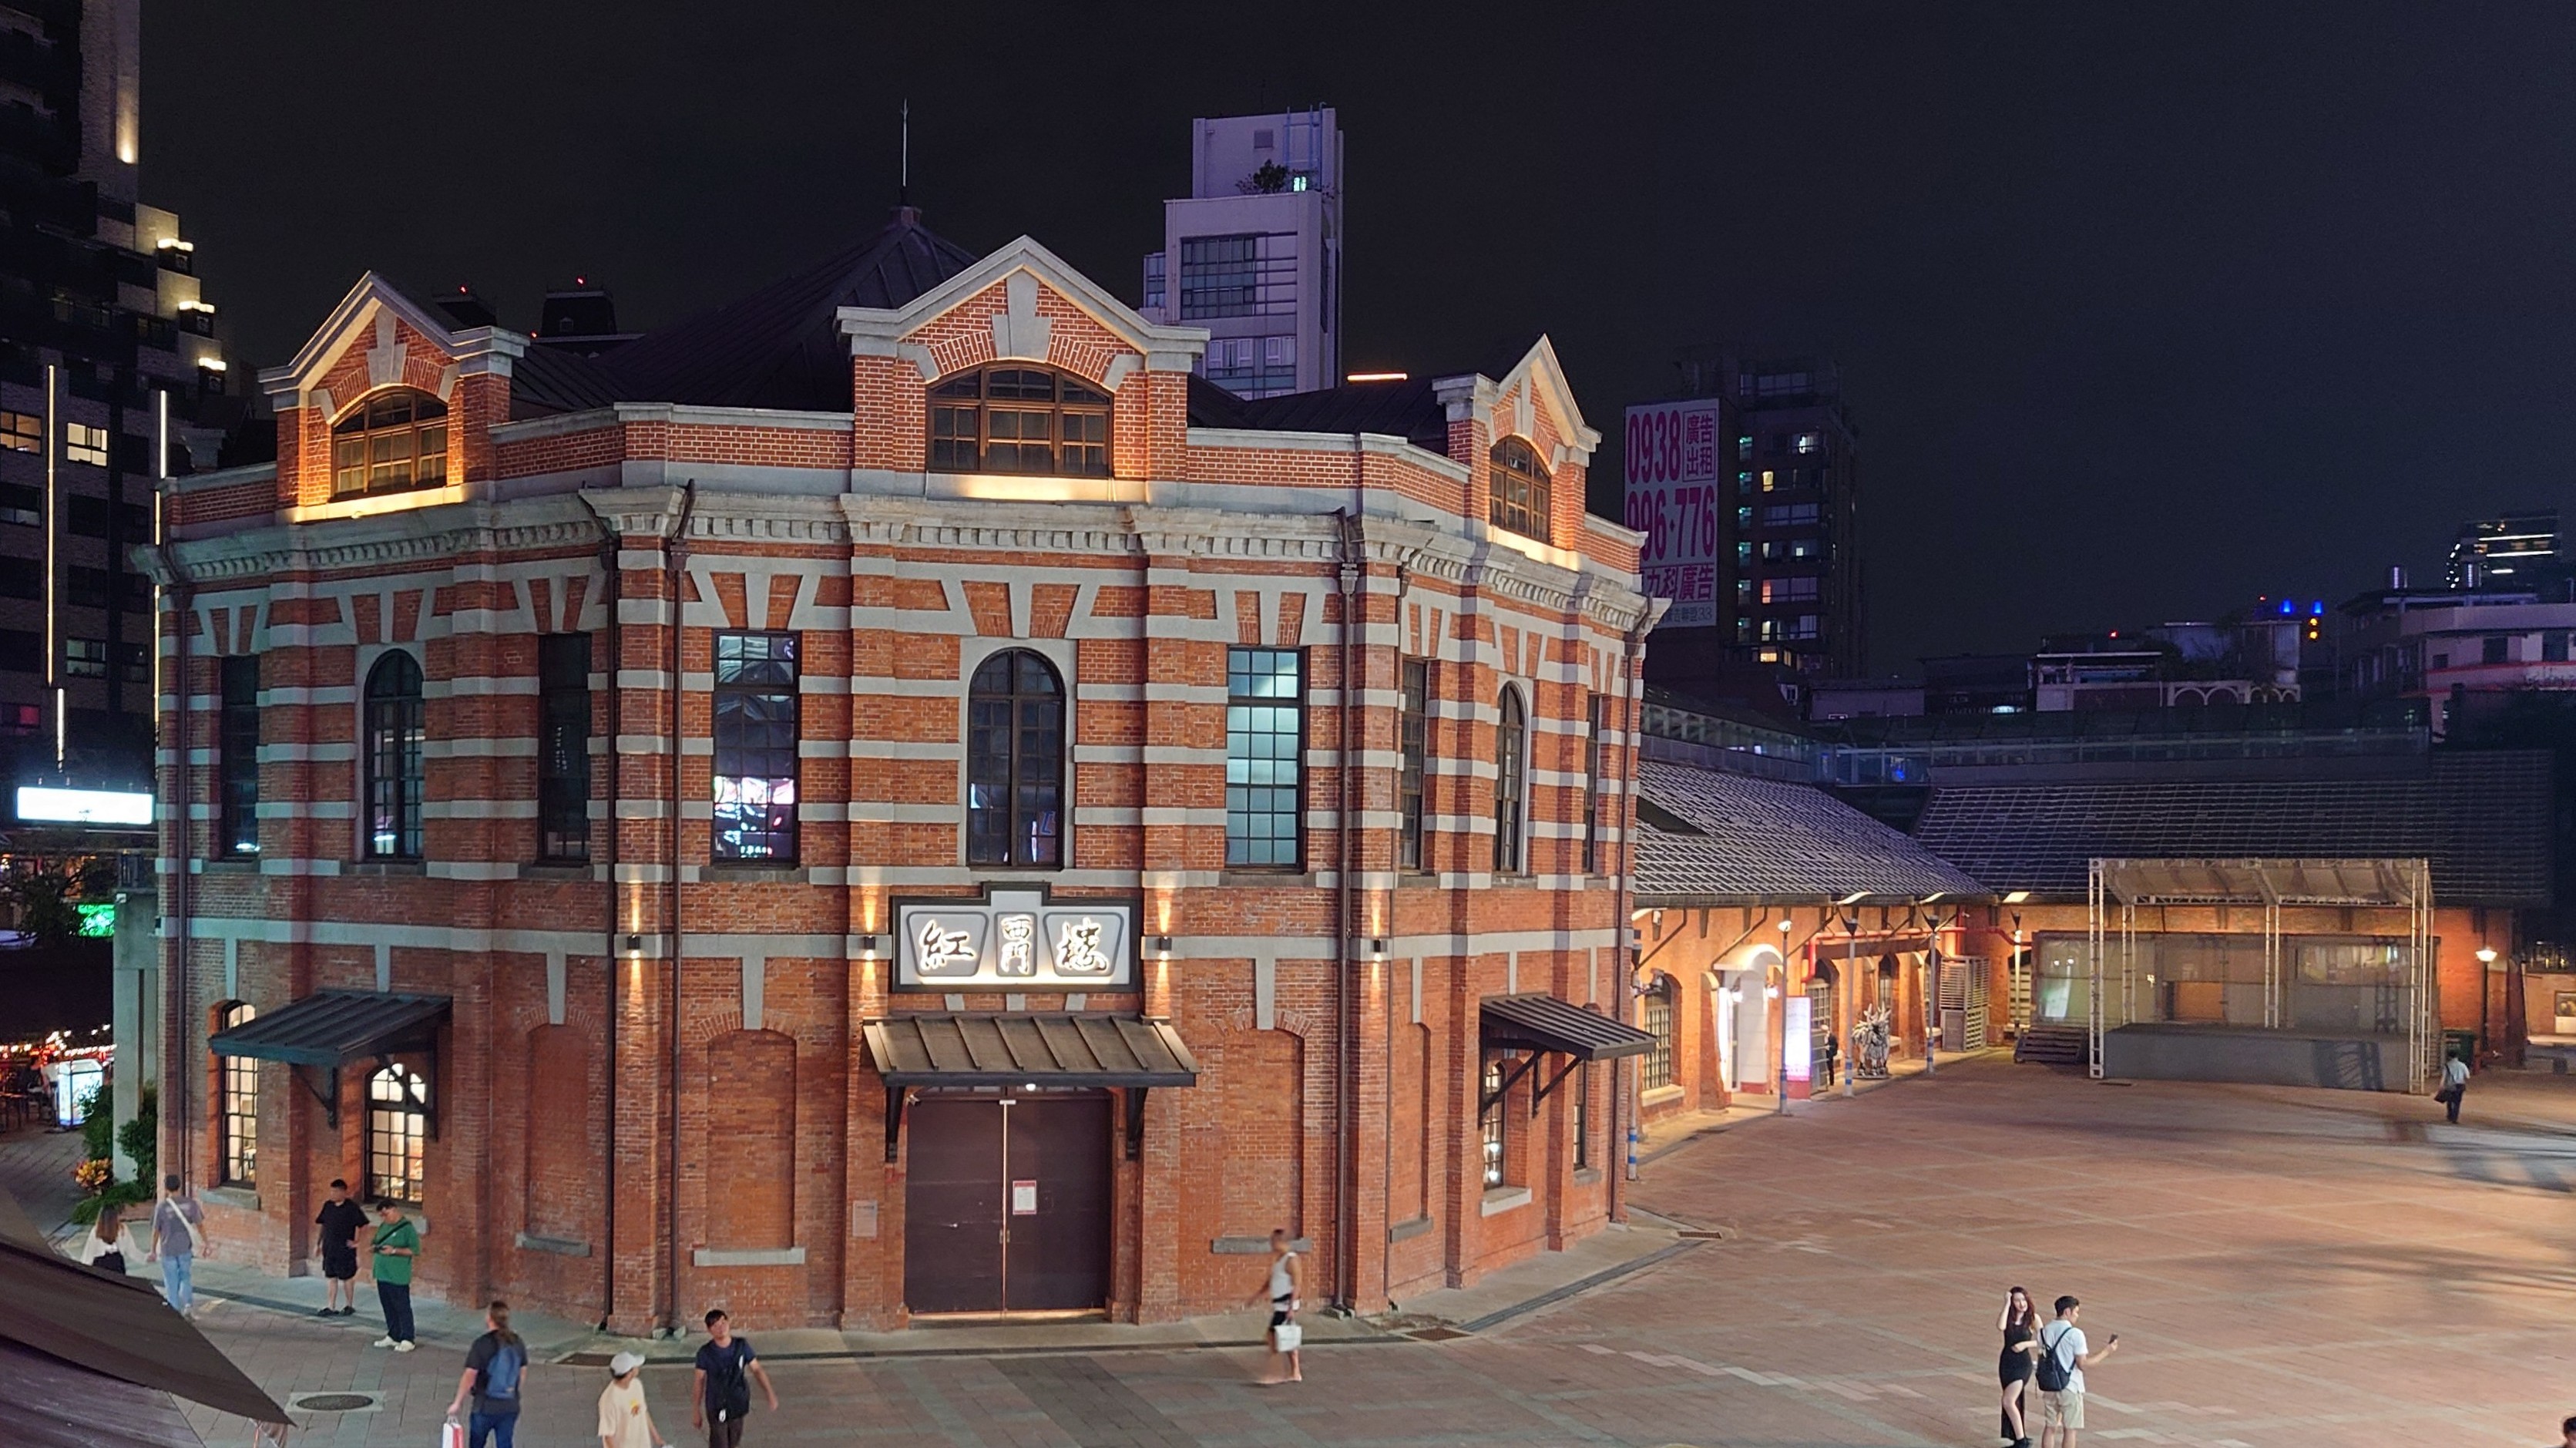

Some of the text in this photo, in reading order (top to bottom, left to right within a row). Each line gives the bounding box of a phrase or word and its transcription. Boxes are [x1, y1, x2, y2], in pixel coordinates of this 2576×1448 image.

[1686, 415, 1713, 445] 廣告
[1627, 409, 1681, 484] 0938
[1686, 446, 1713, 477] 出租
